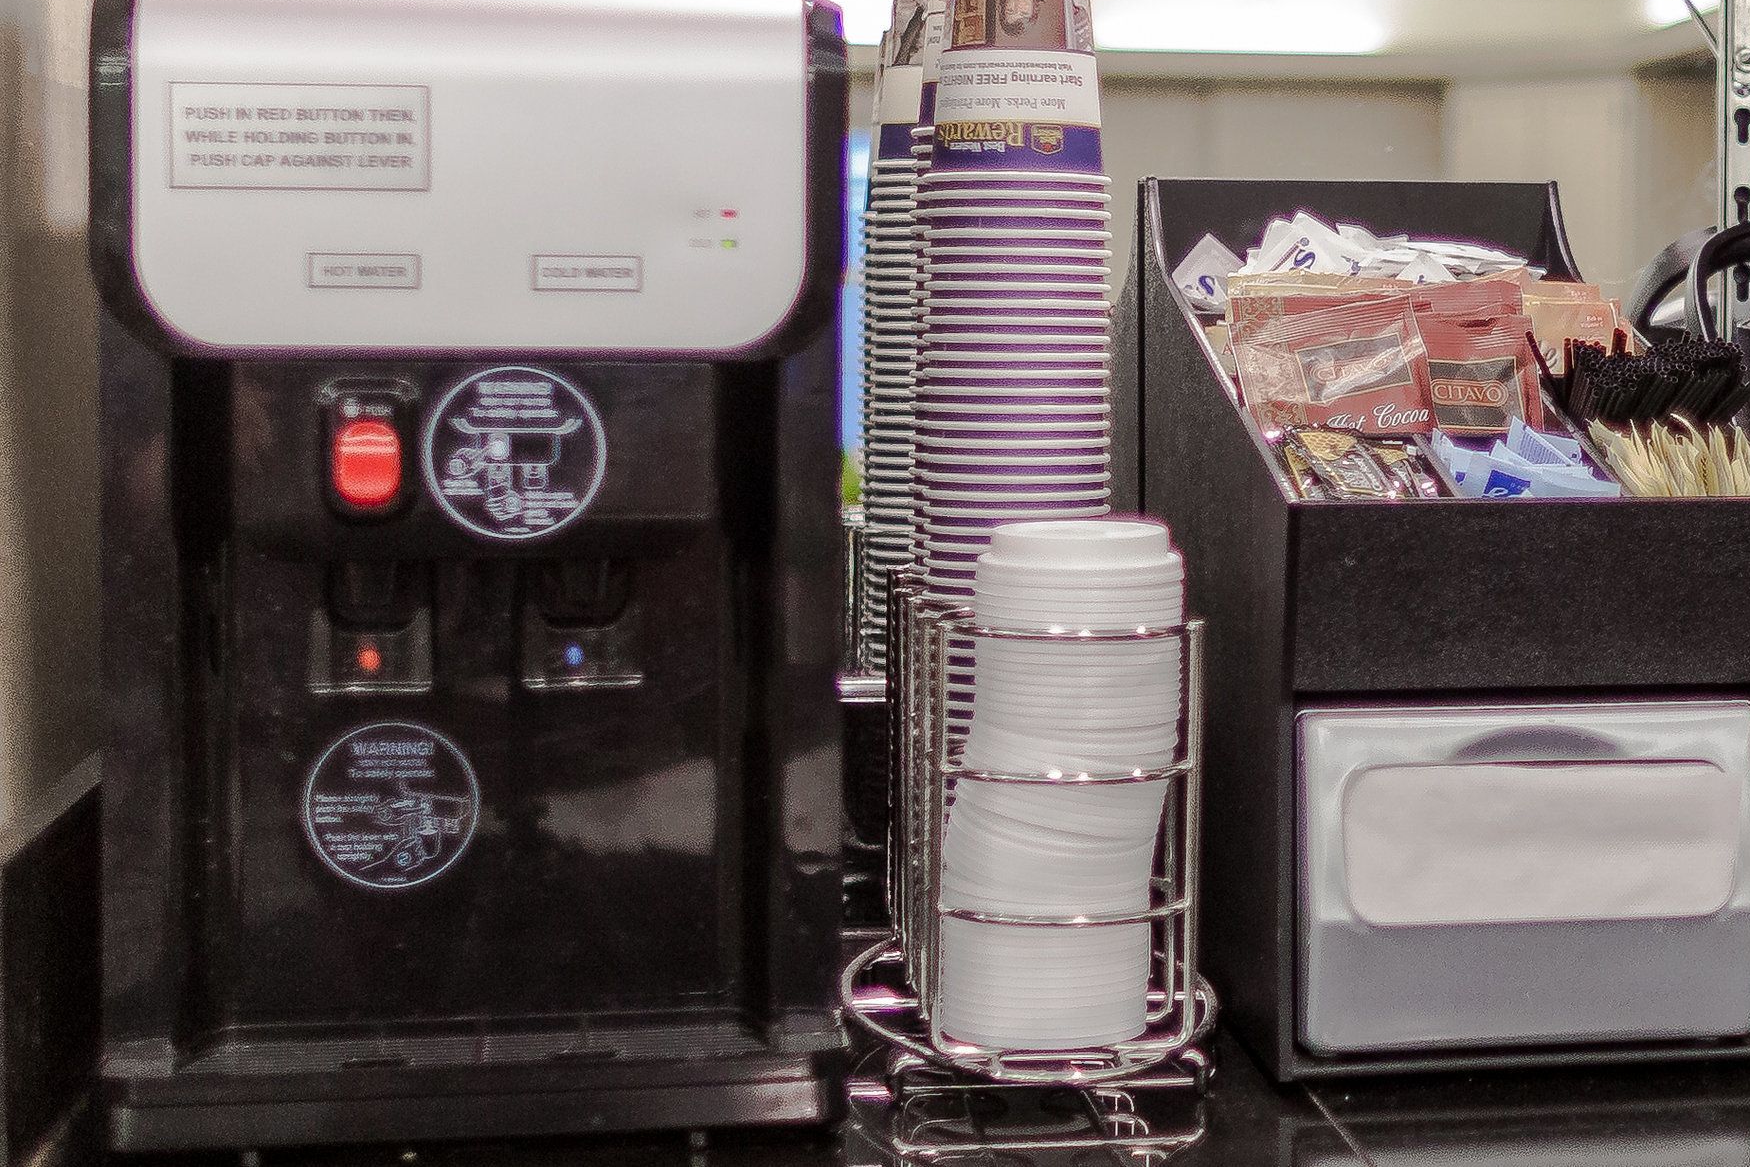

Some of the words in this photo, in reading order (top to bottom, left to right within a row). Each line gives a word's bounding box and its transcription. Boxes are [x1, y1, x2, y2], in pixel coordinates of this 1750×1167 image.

[976, 73, 1008, 85] FREE
[1011, 71, 1057, 85] earning
[1060, 75, 1083, 87] Start
[974, 97, 1002, 110] More
[1003, 97, 1038, 110] Perks.
[1040, 97, 1066, 110] More
[184, 106, 231, 121] PUSH
[236, 107, 251, 121] IN
[256, 107, 291, 121] RED
[295, 107, 364, 122] BUTTON
[243, 130, 318, 145] HOLDING
[324, 131, 392, 146] BUTTON
[938, 120, 1025, 147] Rewards
[983, 141, 1006, 153] Best
[189, 153, 236, 167] PUSH
[279, 154, 353, 168] AGAINST
[357, 154, 413, 169] LEVER
[323, 264, 353, 278] HOT
[357, 265, 408, 279] WATER
[1316, 354, 1394, 382] CITAVO
[1432, 384, 1504, 403] CITAVO
[1373, 402, 1430, 429] Cocoa
